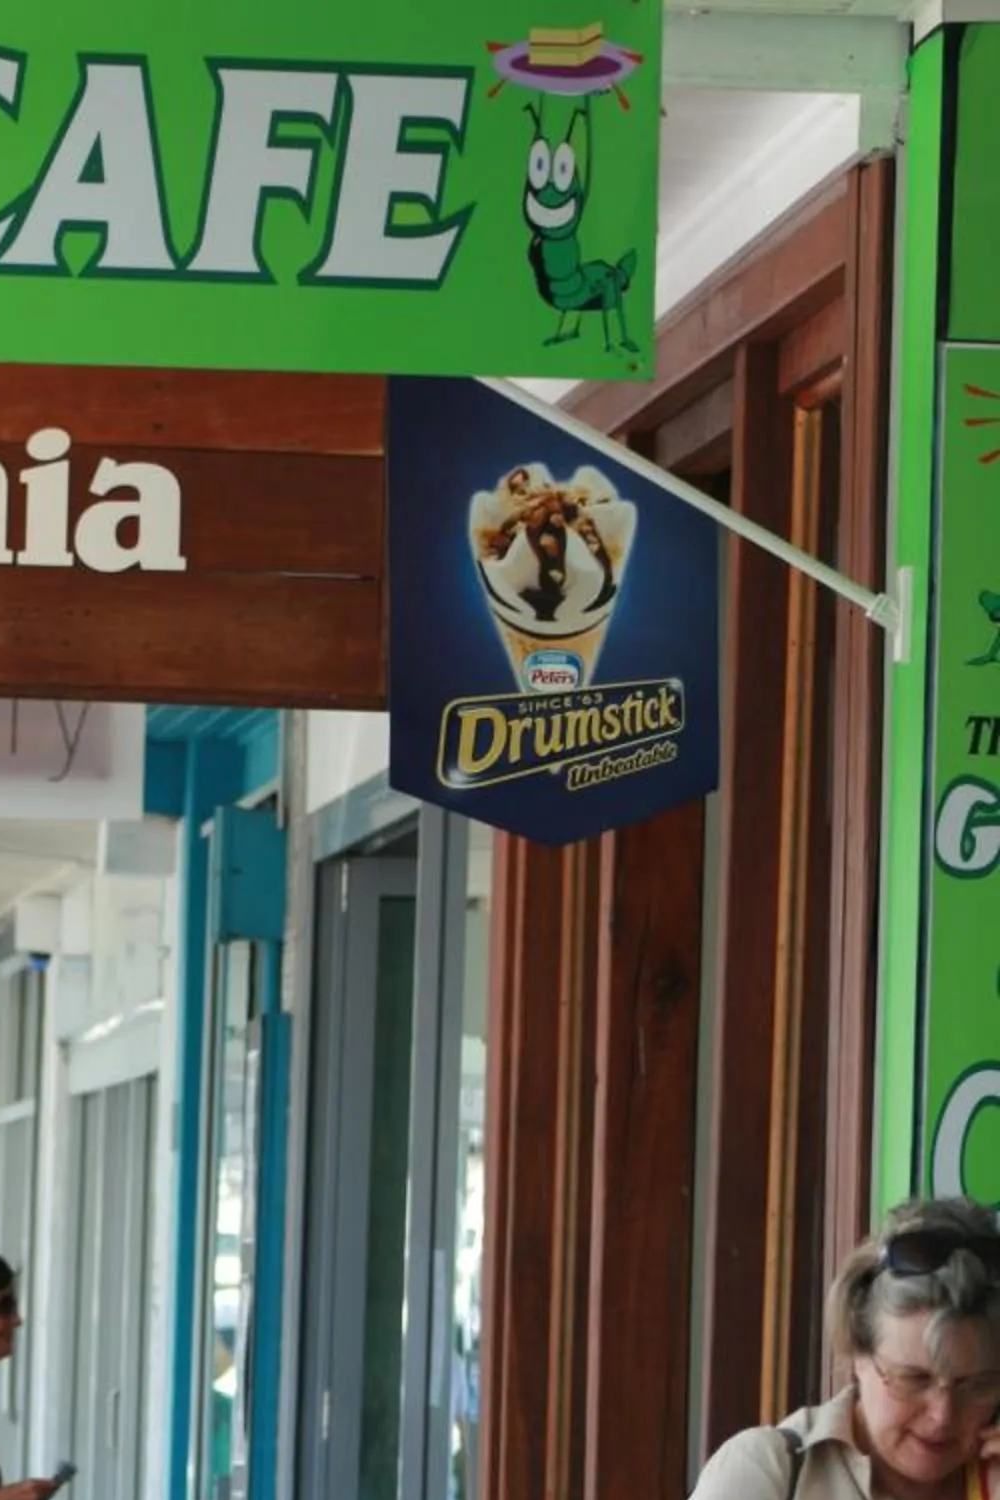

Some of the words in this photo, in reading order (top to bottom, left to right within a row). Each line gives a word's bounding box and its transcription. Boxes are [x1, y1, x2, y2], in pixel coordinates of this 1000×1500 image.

[518, 694, 572, 714] SINCE
[457, 687, 679, 775] Drumstick
[566, 740, 678, 791] Unbeatable
